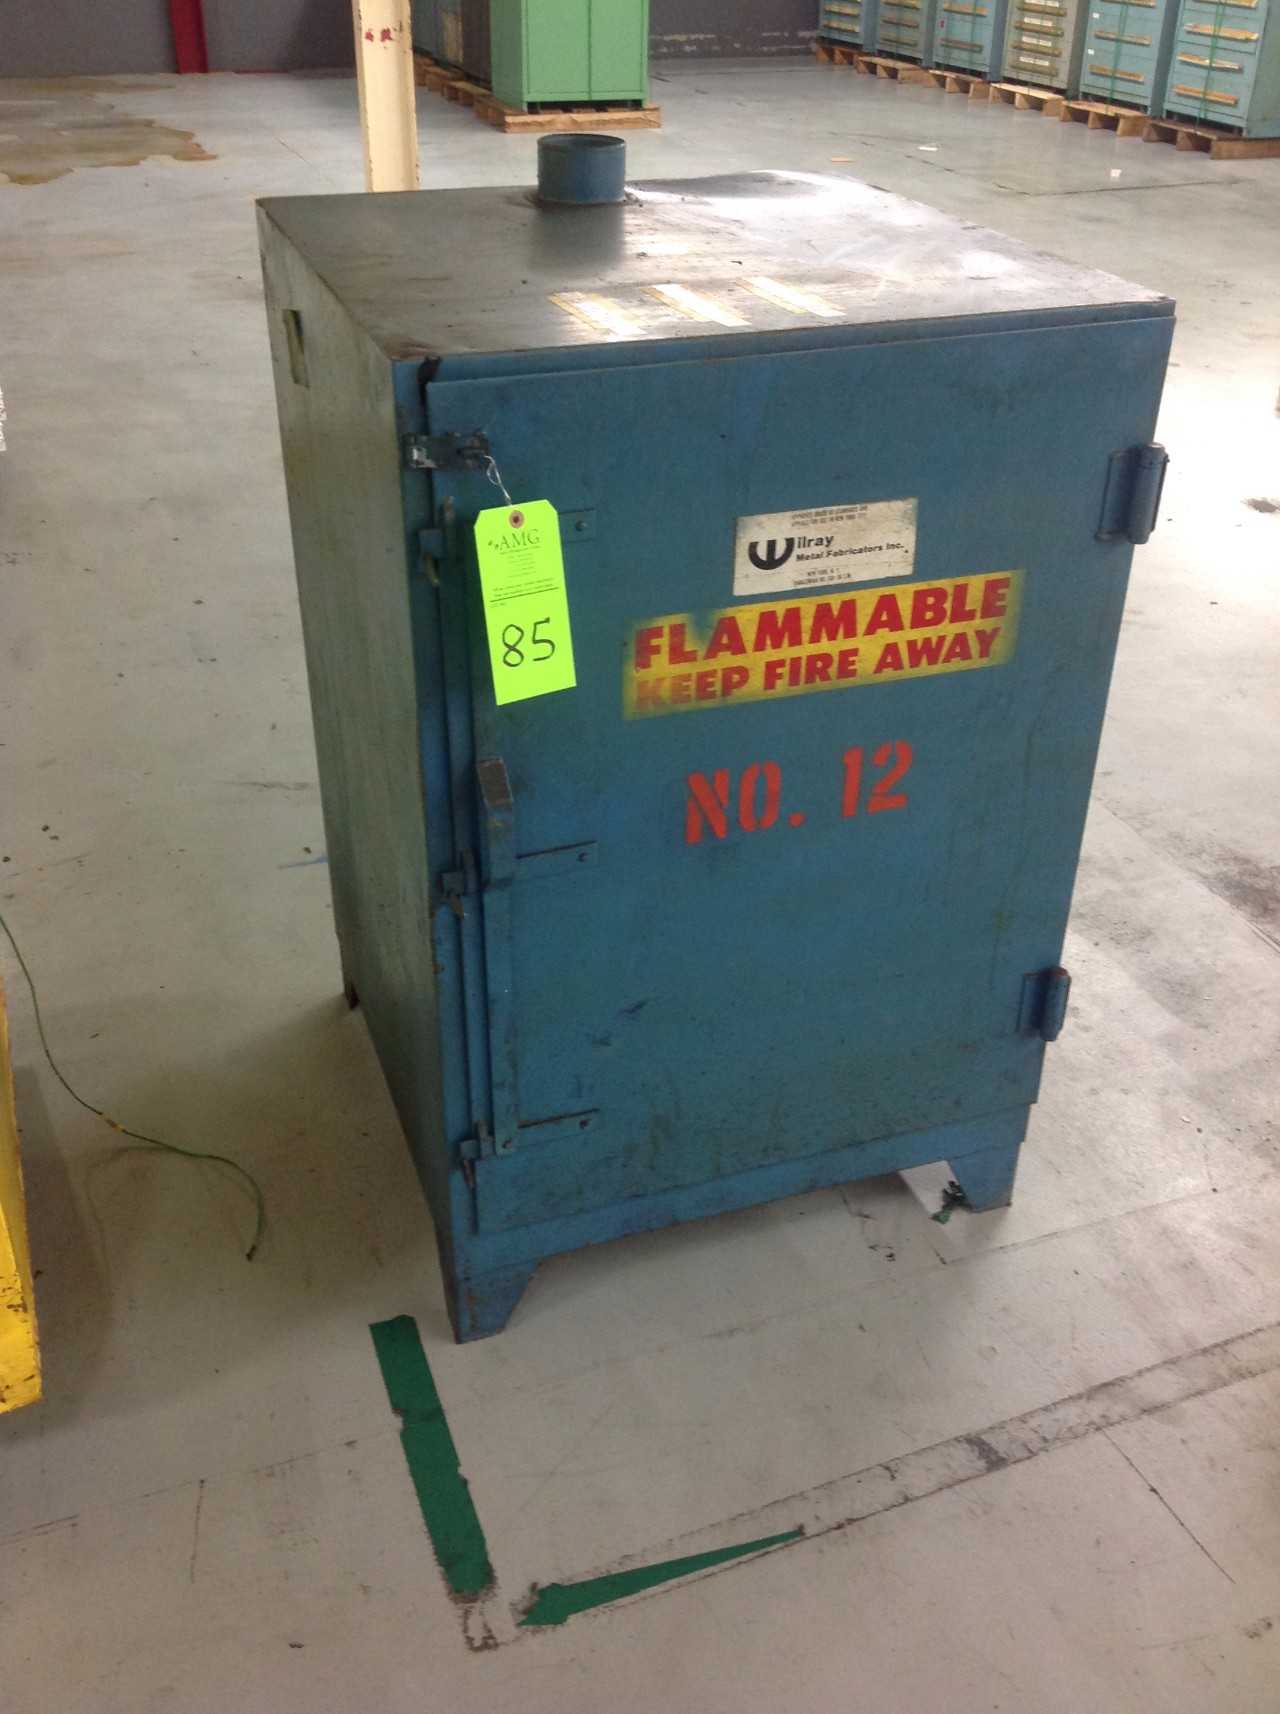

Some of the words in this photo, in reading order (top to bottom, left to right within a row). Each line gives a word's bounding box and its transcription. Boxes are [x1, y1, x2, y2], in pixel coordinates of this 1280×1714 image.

[499, 528, 541, 550] AMG
[796, 551, 824, 562] Metal
[825, 543, 883, 558] Fabricators
[501, 616, 556, 668] 85
[634, 576, 1012, 672] FLAMMABLE
[635, 664, 750, 713] KEEP
[763, 647, 860, 692] FIRE
[873, 626, 1003, 675] AWAY
[685, 760, 807, 846] NO.
[841, 739, 913, 820] 12
